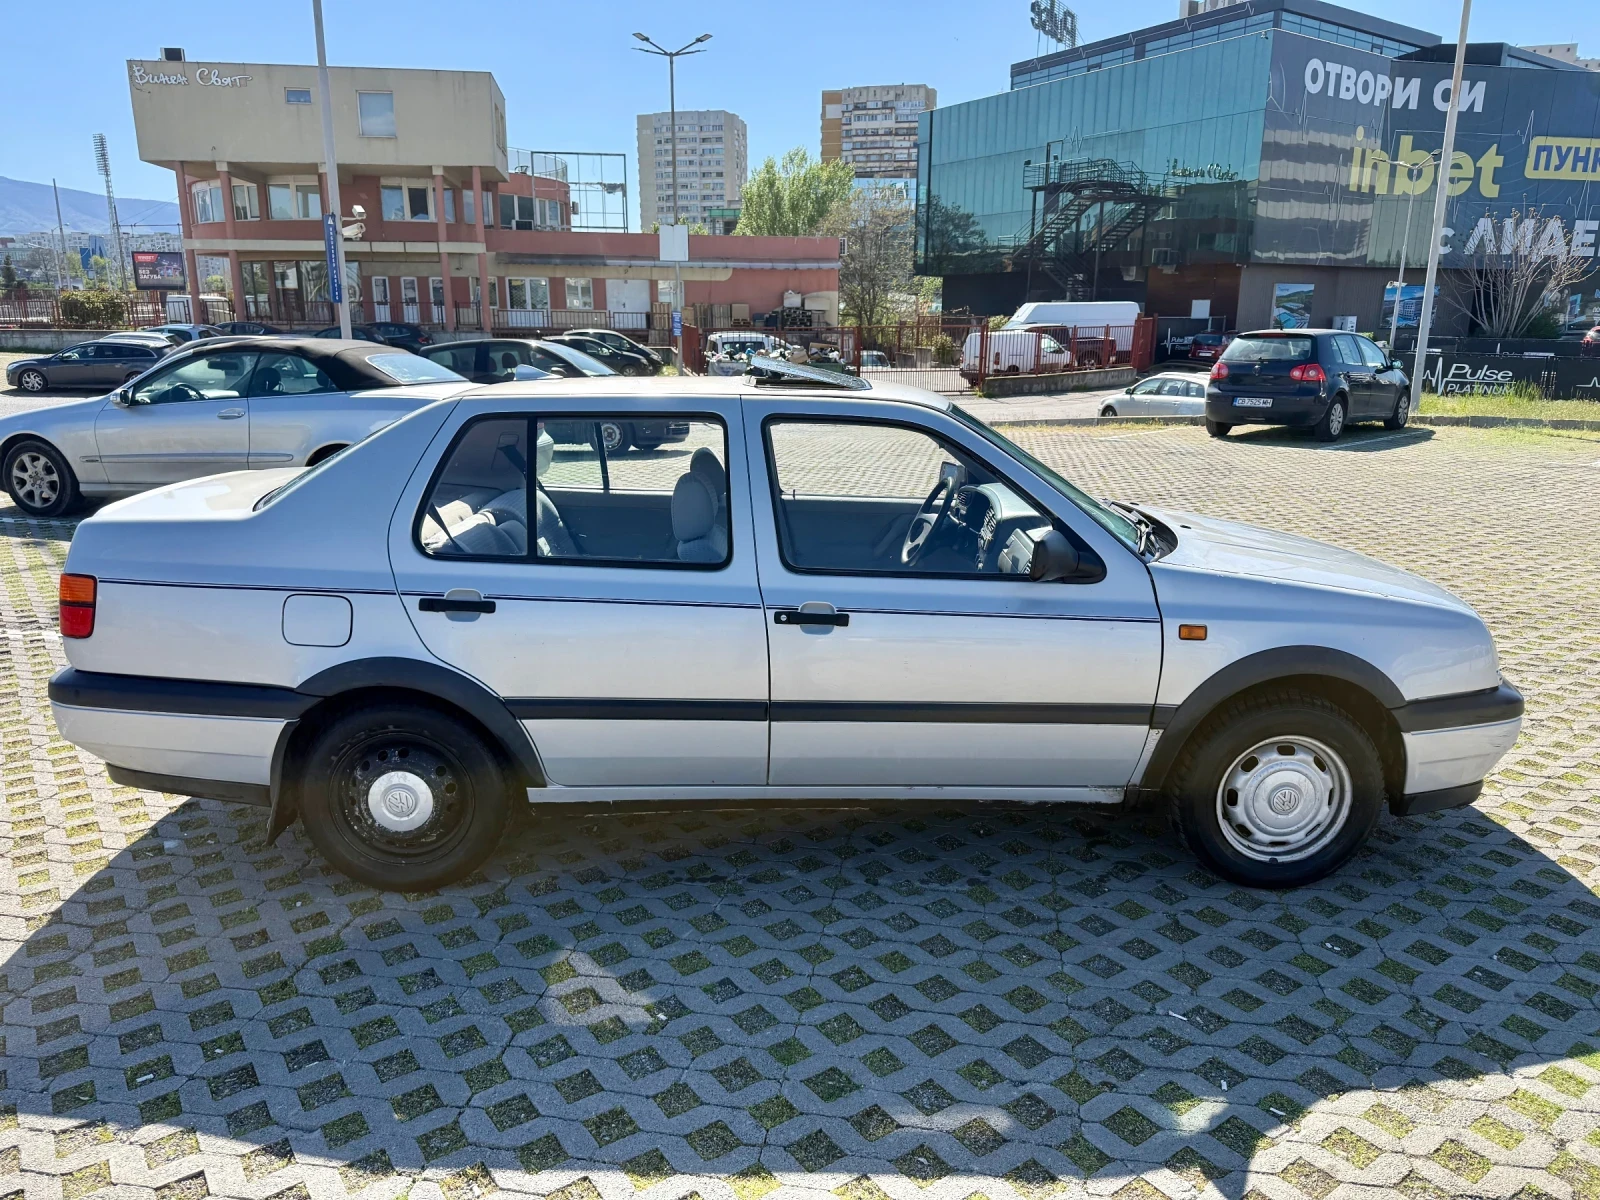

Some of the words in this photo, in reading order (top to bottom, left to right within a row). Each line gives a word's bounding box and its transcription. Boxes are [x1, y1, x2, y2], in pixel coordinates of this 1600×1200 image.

[196, 67, 253, 87] Свят
[1304, 58, 1421, 110] ОТВОРИ
[1432, 79, 1487, 113] СИ
[1349, 125, 1504, 198] inbet
[1463, 217, 1600, 263] ЛИДЕ
[1447, 363, 1513, 381] Pulse
[1446, 383, 1516, 395] PLATINUM
